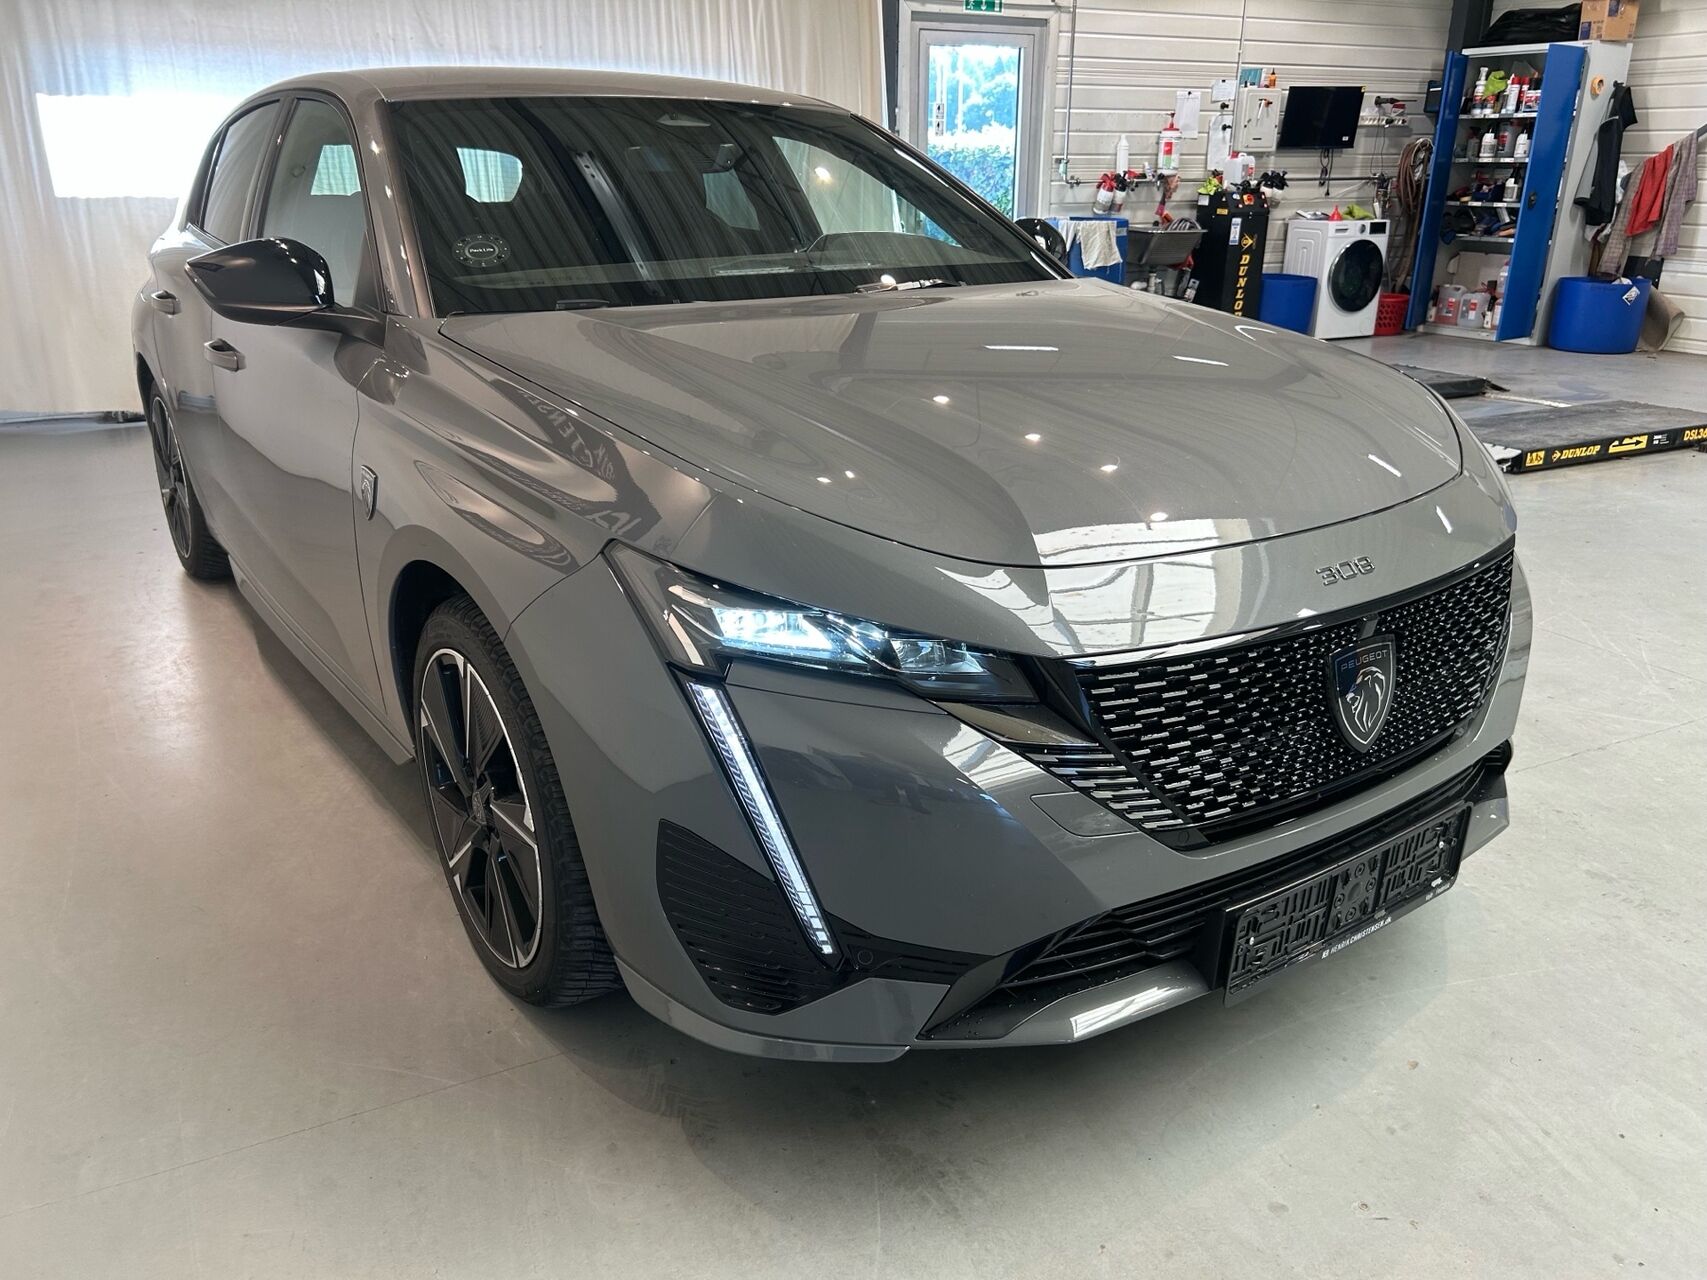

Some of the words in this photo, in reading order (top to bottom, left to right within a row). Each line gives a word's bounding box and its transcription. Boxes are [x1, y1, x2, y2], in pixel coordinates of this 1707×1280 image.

[1560, 445, 1601, 460] DUNLOP
[1316, 556, 1375, 587] 308
[1340, 650, 1388, 672] PEUGEOT
